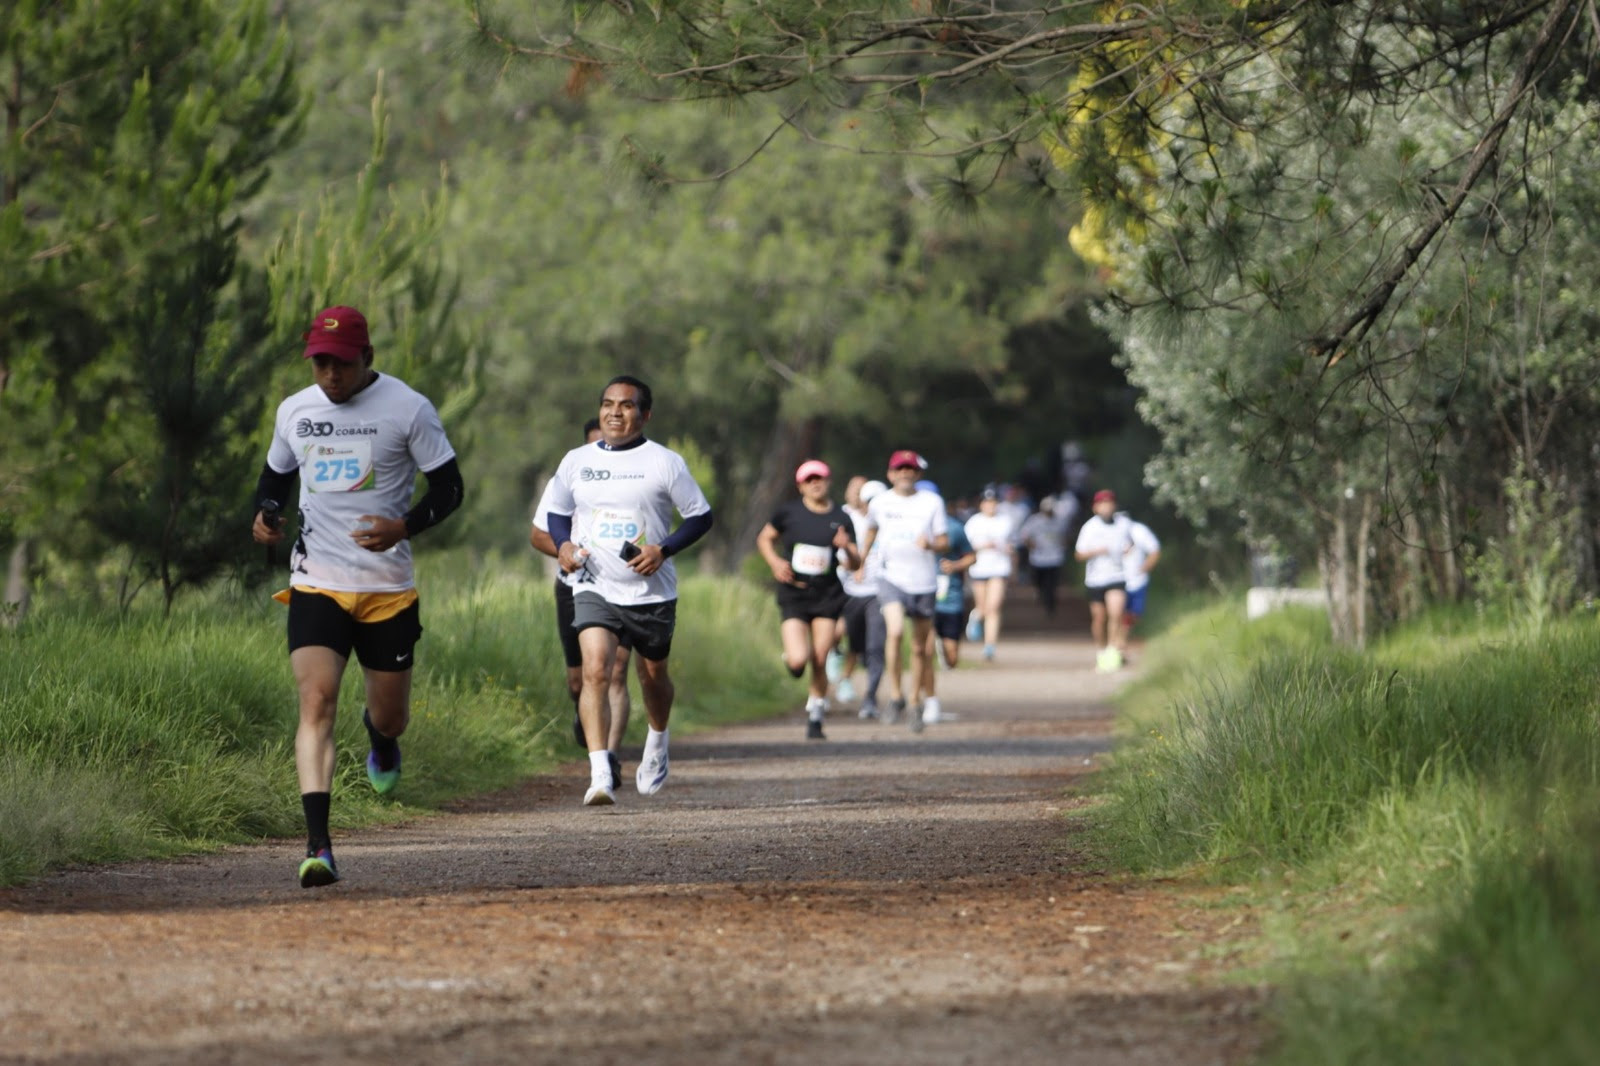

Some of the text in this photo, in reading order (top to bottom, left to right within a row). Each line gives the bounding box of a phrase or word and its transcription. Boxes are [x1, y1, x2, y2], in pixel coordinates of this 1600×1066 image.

[312, 421, 378, 437] 30 COBAEM
[314, 458, 361, 482] 275
[594, 469, 611, 481] 30
[599, 522, 638, 539] 259
